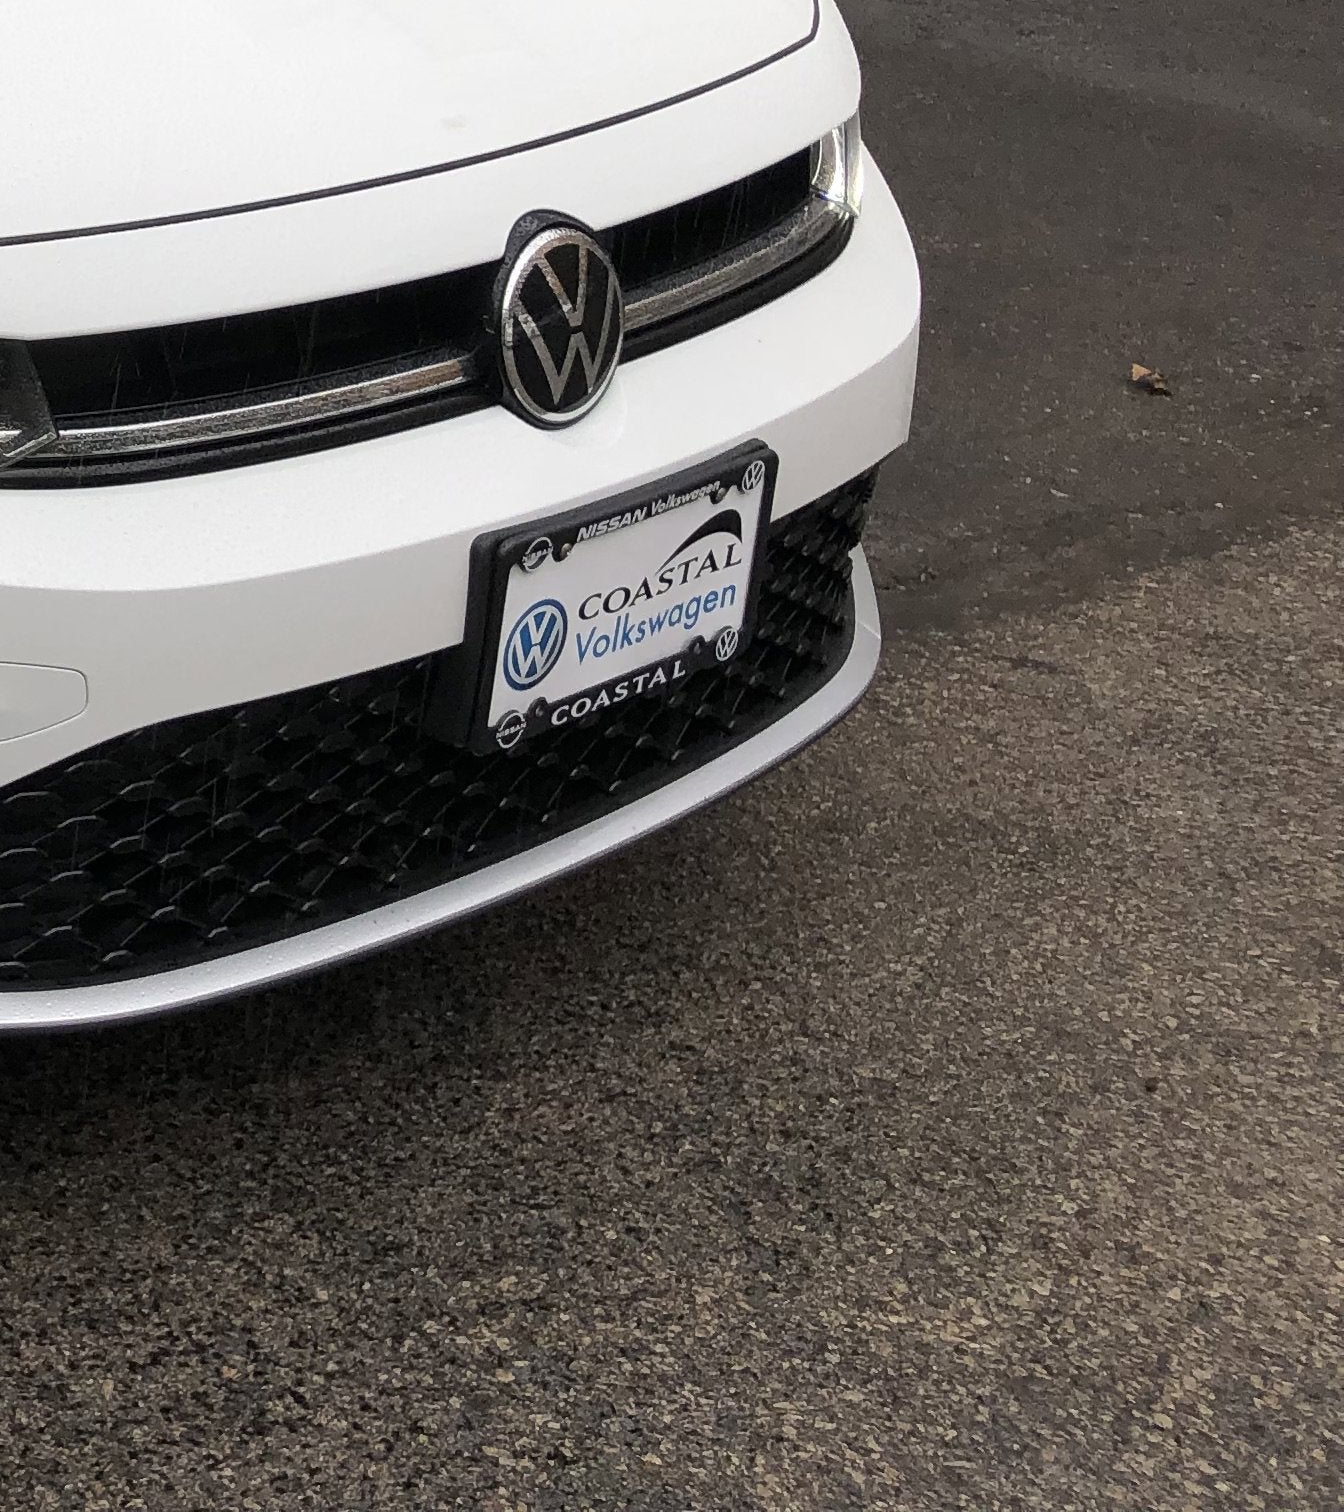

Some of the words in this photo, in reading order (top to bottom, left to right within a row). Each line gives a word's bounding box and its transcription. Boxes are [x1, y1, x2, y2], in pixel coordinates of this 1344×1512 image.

[576, 506, 648, 543] NISSAN
[651, 480, 721, 517] Volkswagen
[578, 543, 742, 620] COASTAL
[575, 584, 736, 665] Volkswagen
[550, 660, 686, 726] COASTAL
